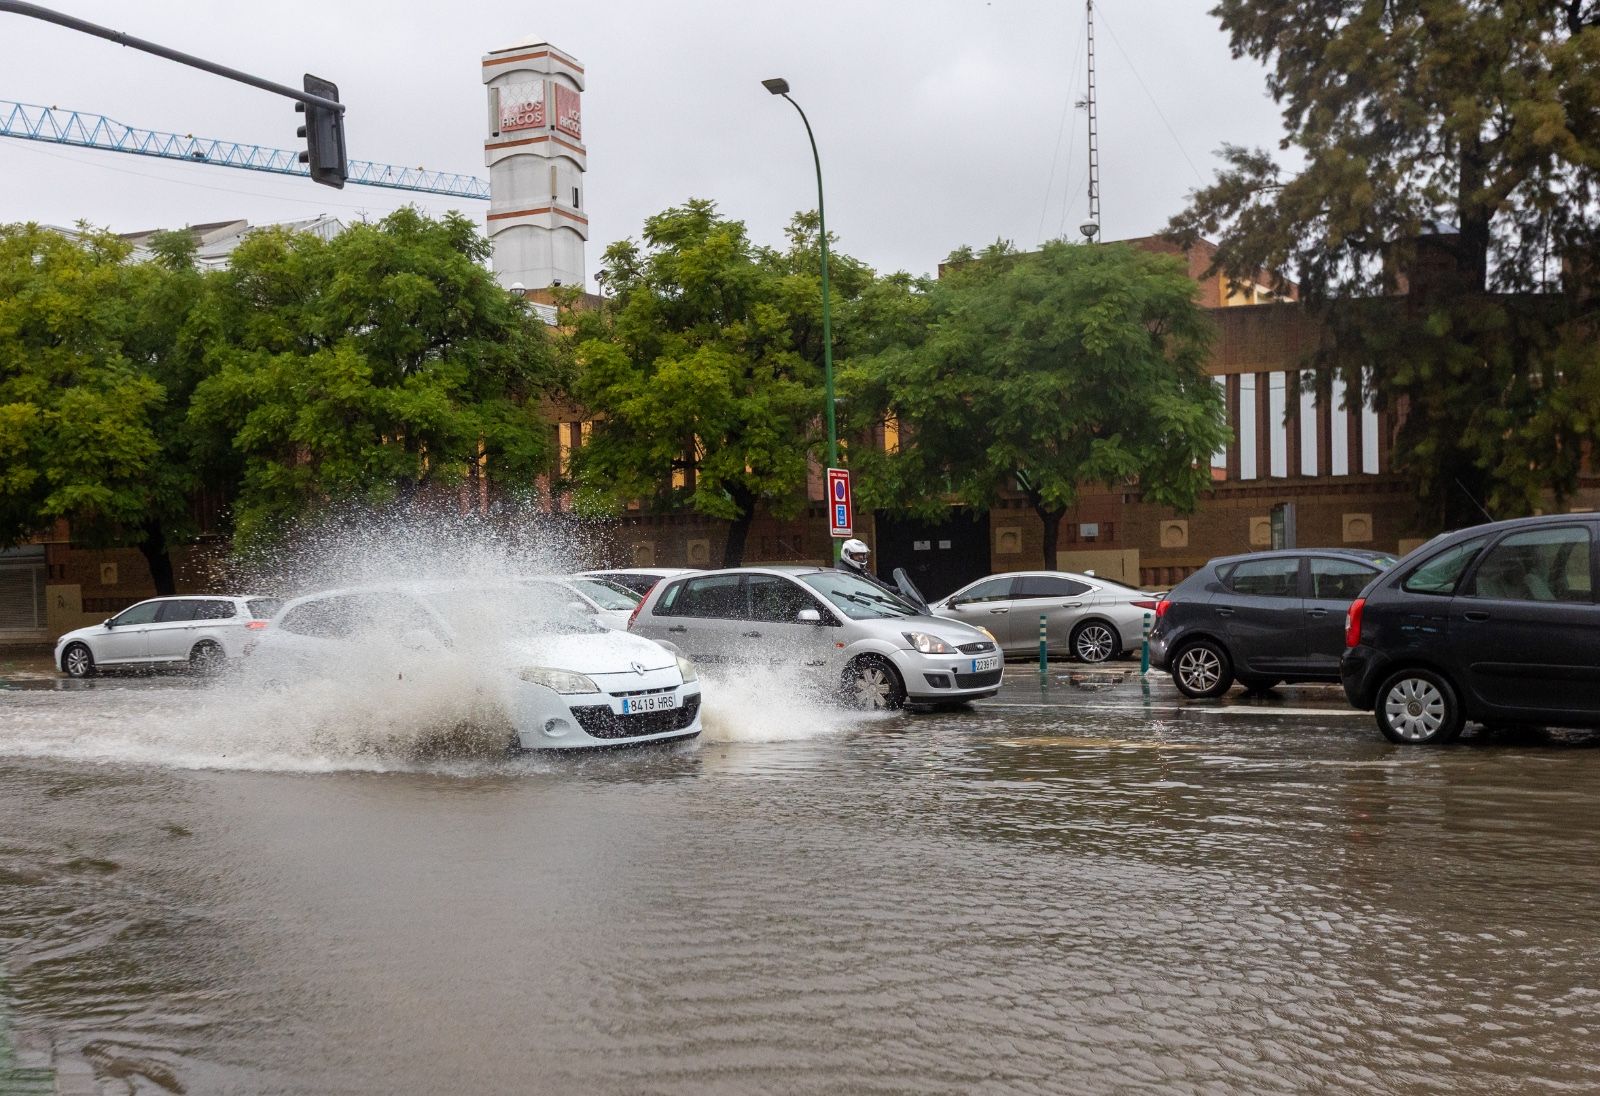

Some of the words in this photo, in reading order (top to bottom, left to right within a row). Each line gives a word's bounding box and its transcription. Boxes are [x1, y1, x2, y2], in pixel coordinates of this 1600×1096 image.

[520, 101, 542, 113] LOS
[502, 112, 542, 127] ARCOS
[976, 660, 989, 670] 2239
[631, 698, 655, 711] 8419
[657, 696, 674, 709] HRS
